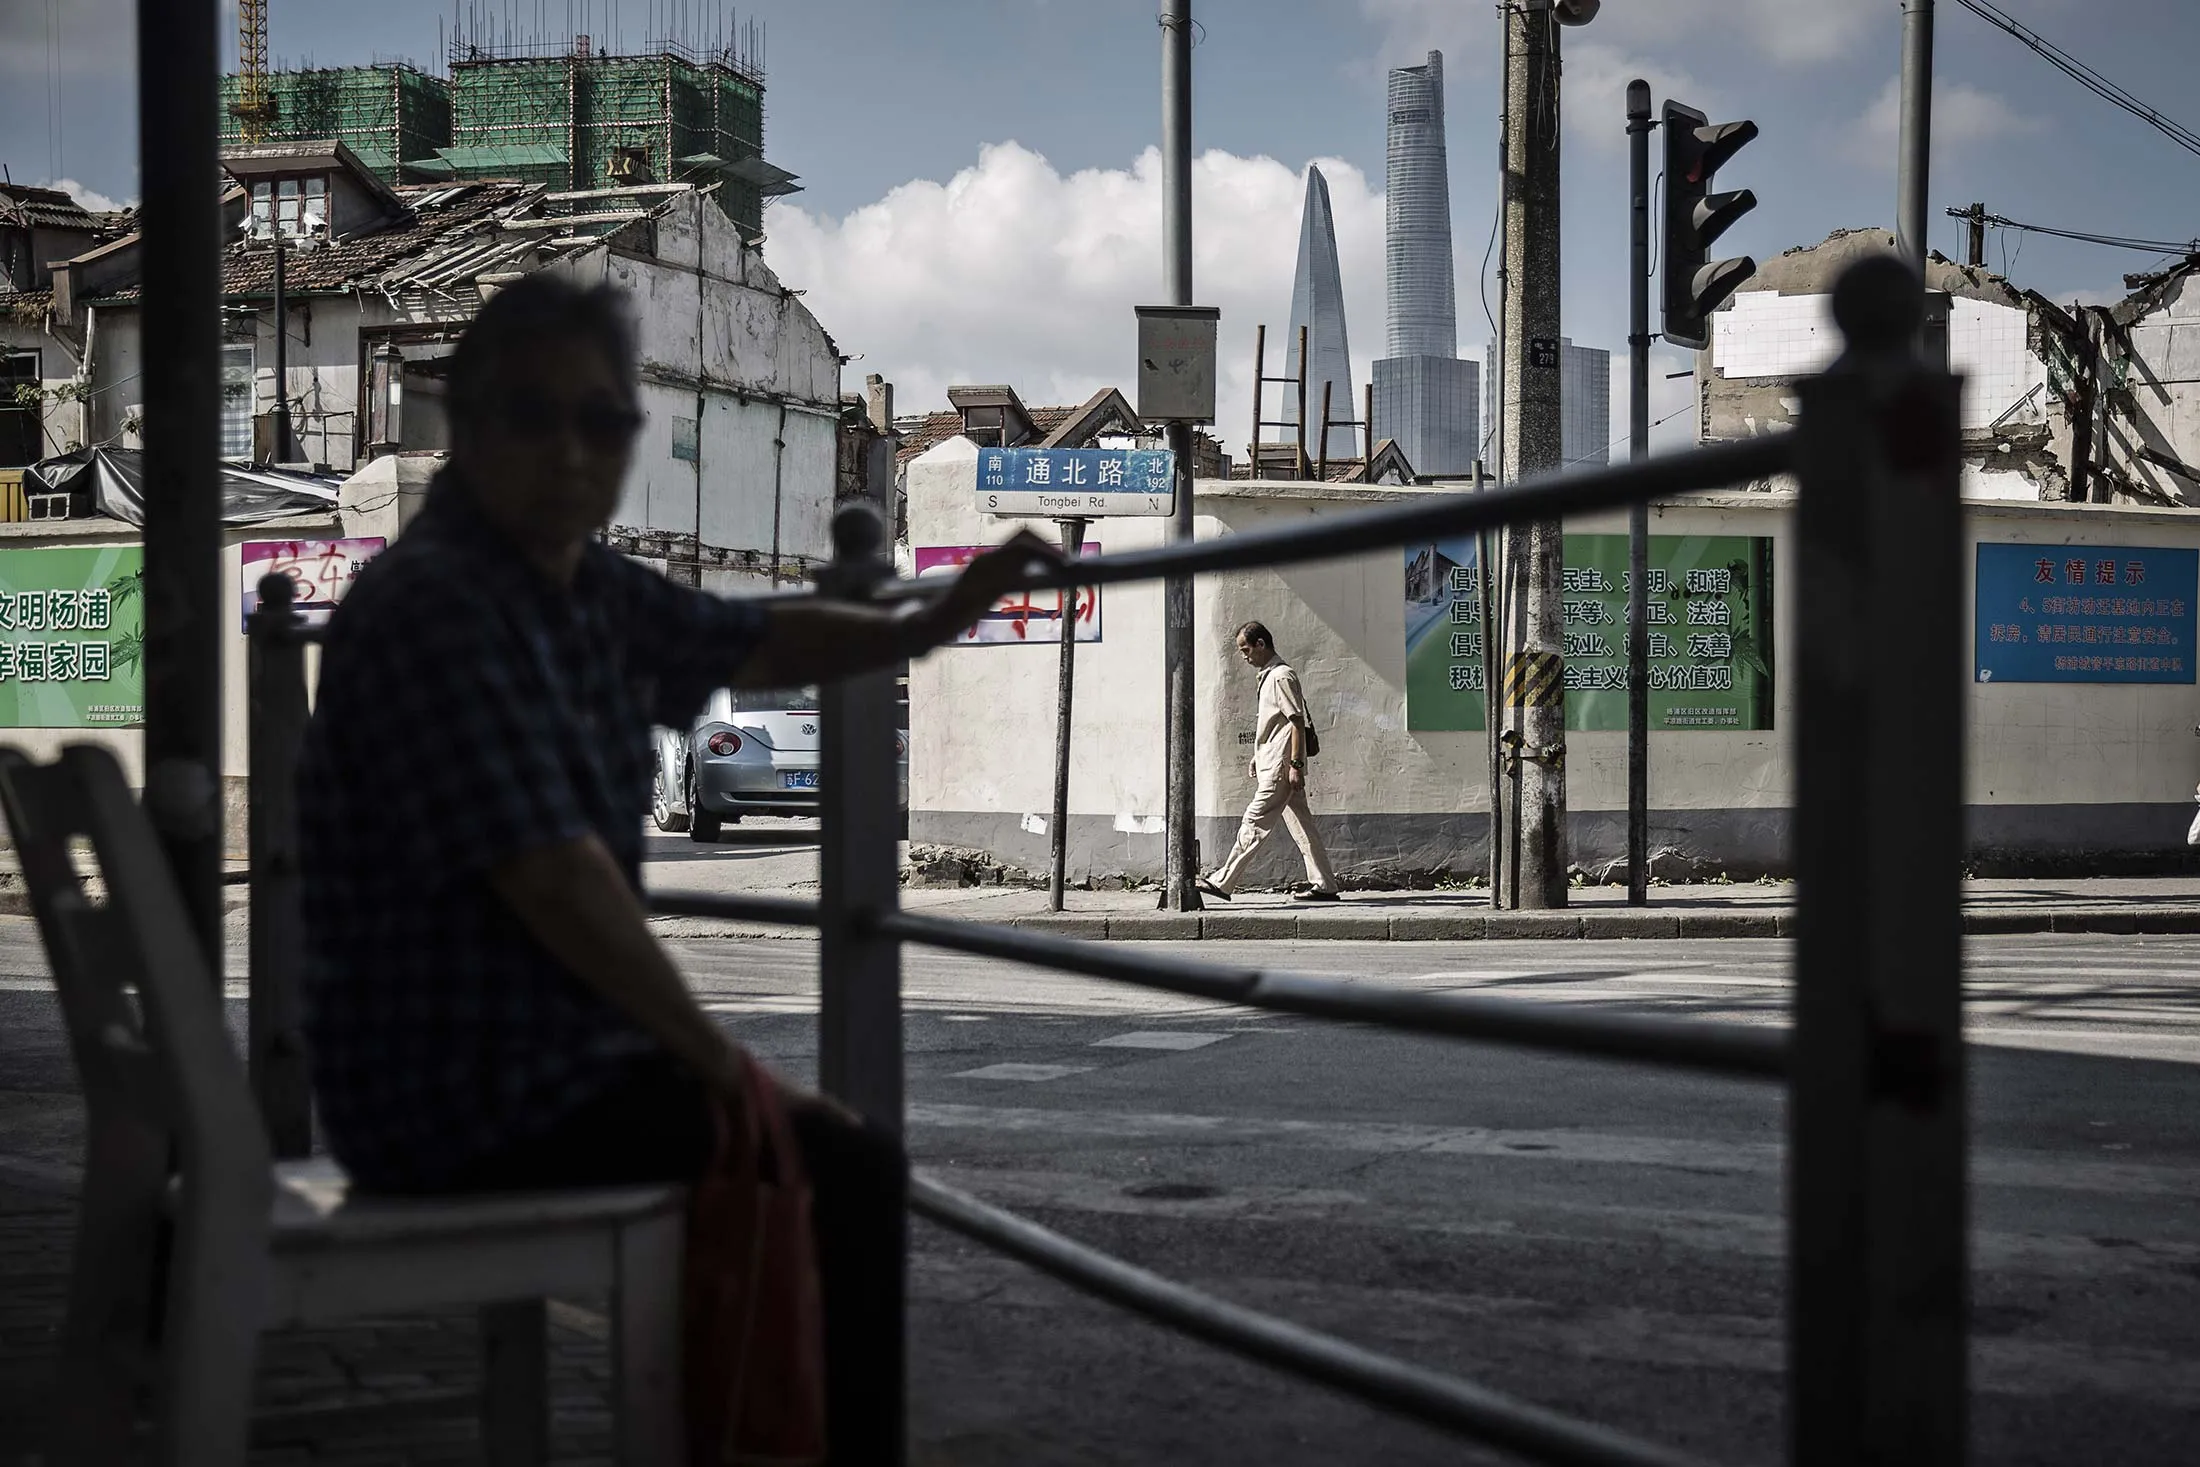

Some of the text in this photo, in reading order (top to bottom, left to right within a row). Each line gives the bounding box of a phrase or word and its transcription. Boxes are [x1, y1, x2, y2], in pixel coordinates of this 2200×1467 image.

[988, 456, 1002, 472] 南
[1148, 459, 1163, 474] 北
[1025, 458, 1124, 486] 通北路
[986, 475, 1003, 486] 110
[1148, 477, 1165, 489] 192
[988, 496, 998, 508] S
[1038, 496, 1108, 508] Tongbei Rd.
[1148, 498, 1159, 511] N
[2034, 558, 2146, 584] 友情提示
[0, 589, 111, 630] 文明杨浦
